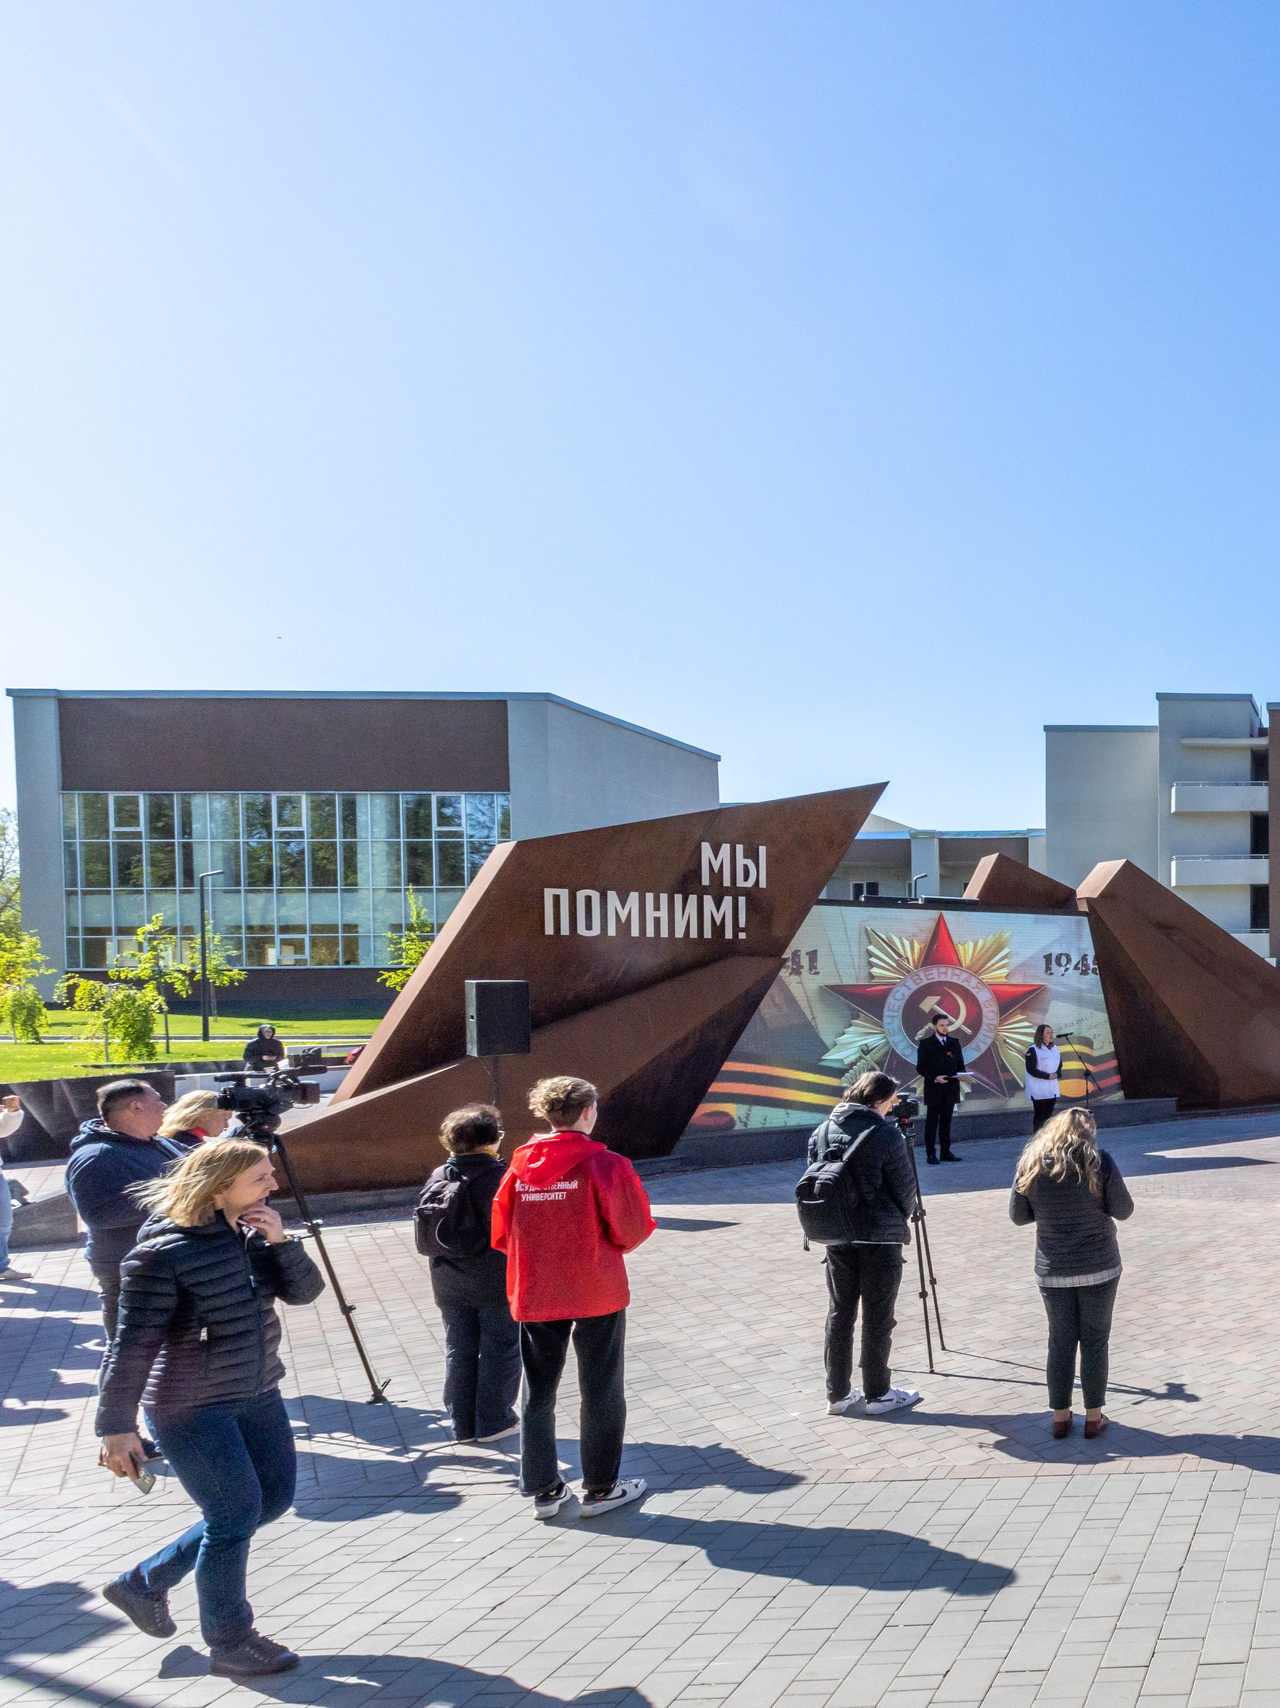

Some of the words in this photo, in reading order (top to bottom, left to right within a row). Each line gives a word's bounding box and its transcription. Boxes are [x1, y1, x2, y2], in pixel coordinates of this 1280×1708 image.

[701, 842, 766, 888] МЫ
[544, 888, 747, 939] ПОМНИМ!
[521, 1192, 567, 1201] УНИВЕРСИТЕТ
